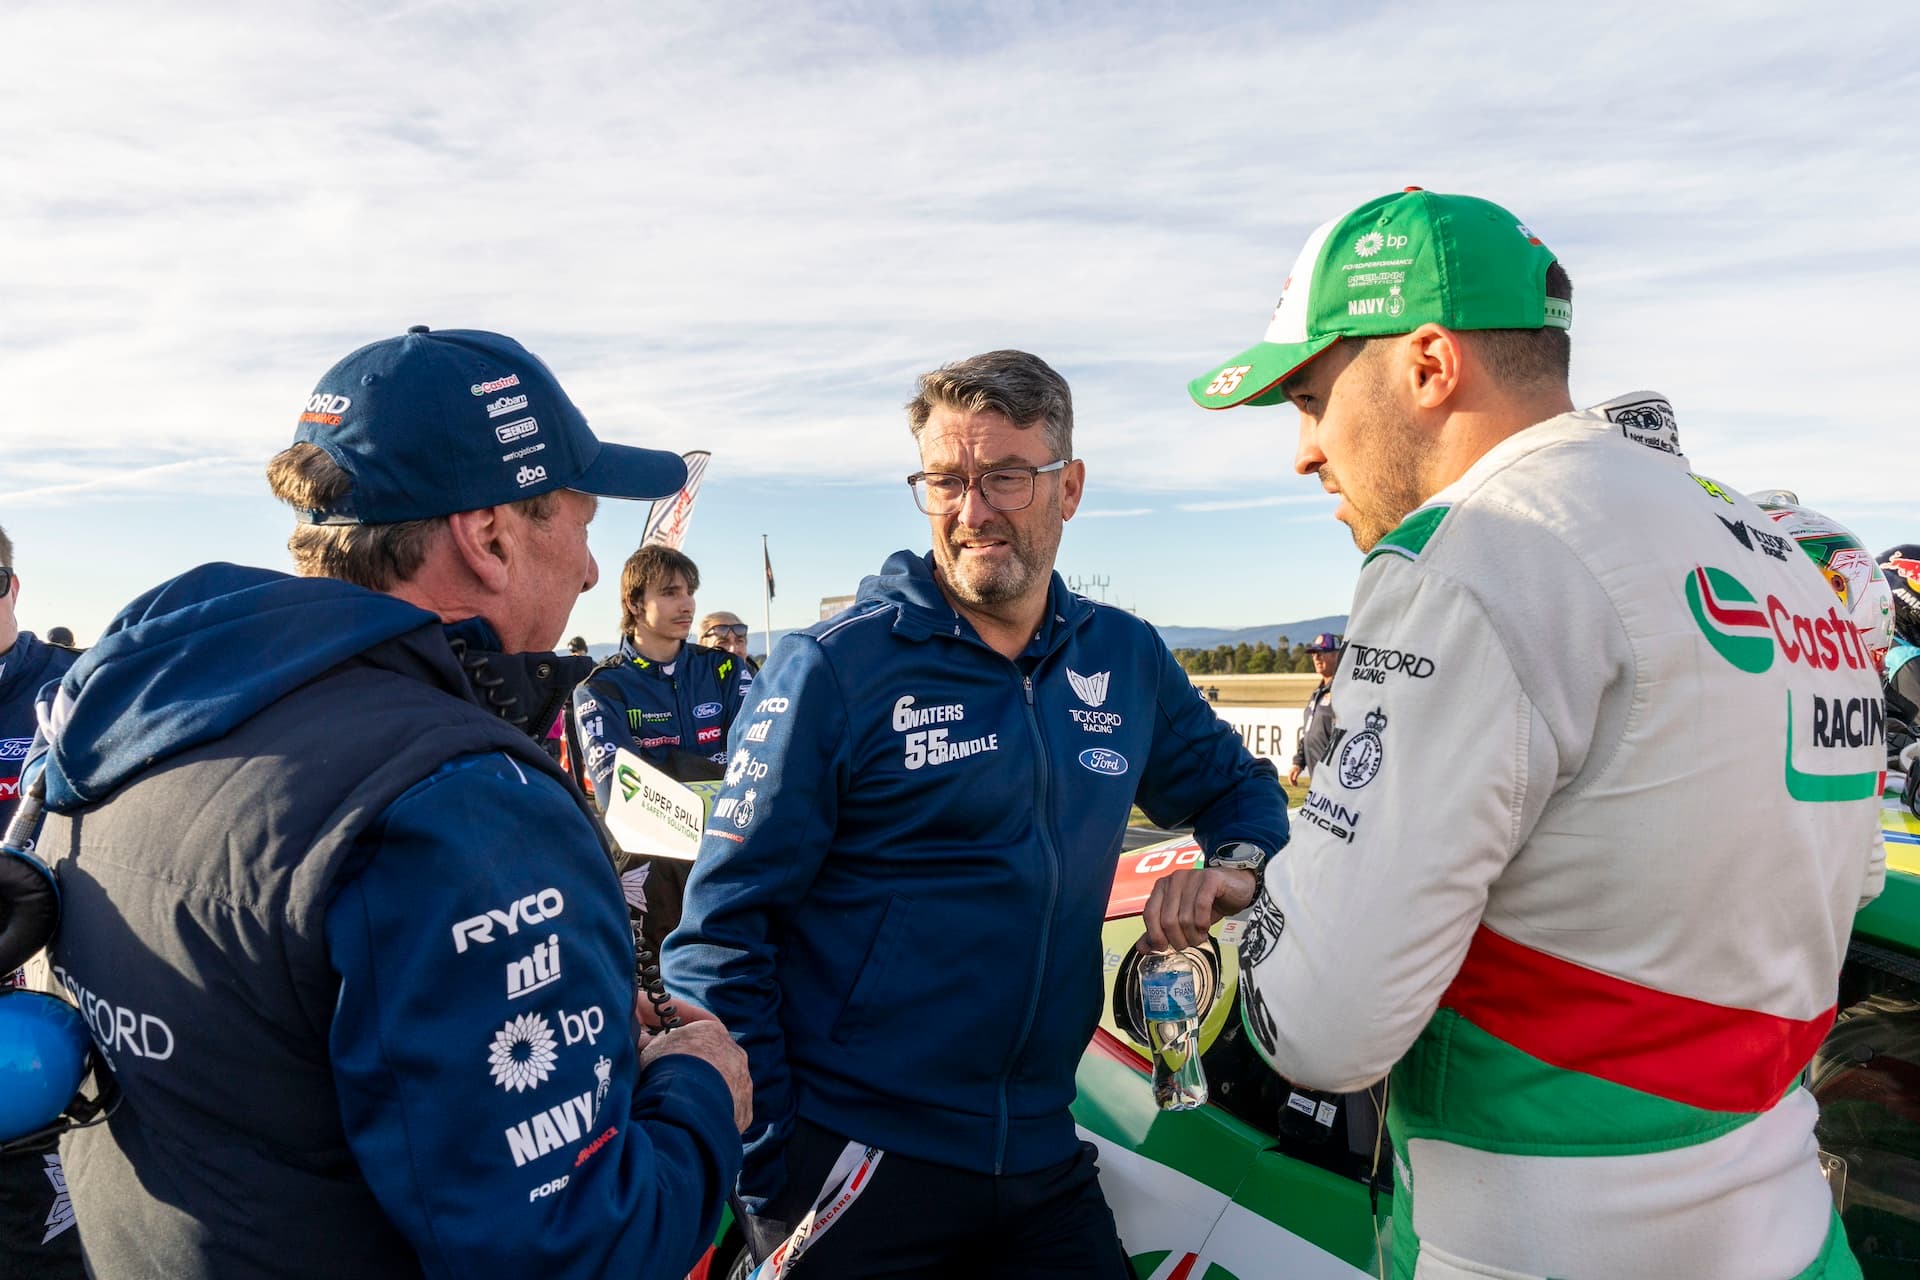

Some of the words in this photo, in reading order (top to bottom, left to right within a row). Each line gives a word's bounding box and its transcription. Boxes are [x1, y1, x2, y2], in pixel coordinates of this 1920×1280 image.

[1386, 234, 1408, 249] bp
[1348, 298, 1385, 316] NAVY
[482, 375, 519, 393] Castrol
[1205, 365, 1253, 397] 55
[304, 393, 352, 415] ORD
[516, 465, 547, 485] dba
[756, 697, 789, 714] YCO
[892, 695, 916, 732] 6
[906, 703, 965, 729] WATERS
[1069, 709, 1122, 727] TICKFORD
[745, 719, 773, 743] nti
[1083, 722, 1113, 734] RACING
[1813, 693, 1888, 749] RACIN
[0, 740, 31, 757] For
[904, 728, 949, 771] 55
[938, 733, 999, 764] RANDLE
[1233, 724, 1283, 756] VER
[747, 757, 769, 782] bp
[1090, 750, 1120, 771] Ford
[643, 785, 673, 814] SUPER
[674, 805, 700, 832] SPILL
[646, 804, 667, 822] SAFETY
[667, 817, 699, 843] SOLUTIONS
[452, 887, 564, 954] RYCO
[507, 934, 561, 1000] nti
[53, 965, 175, 1061] TCKFORD
[558, 1005, 605, 1047] bp
[505, 1090, 593, 1168] NAVY
[529, 1174, 570, 1203] FORD
